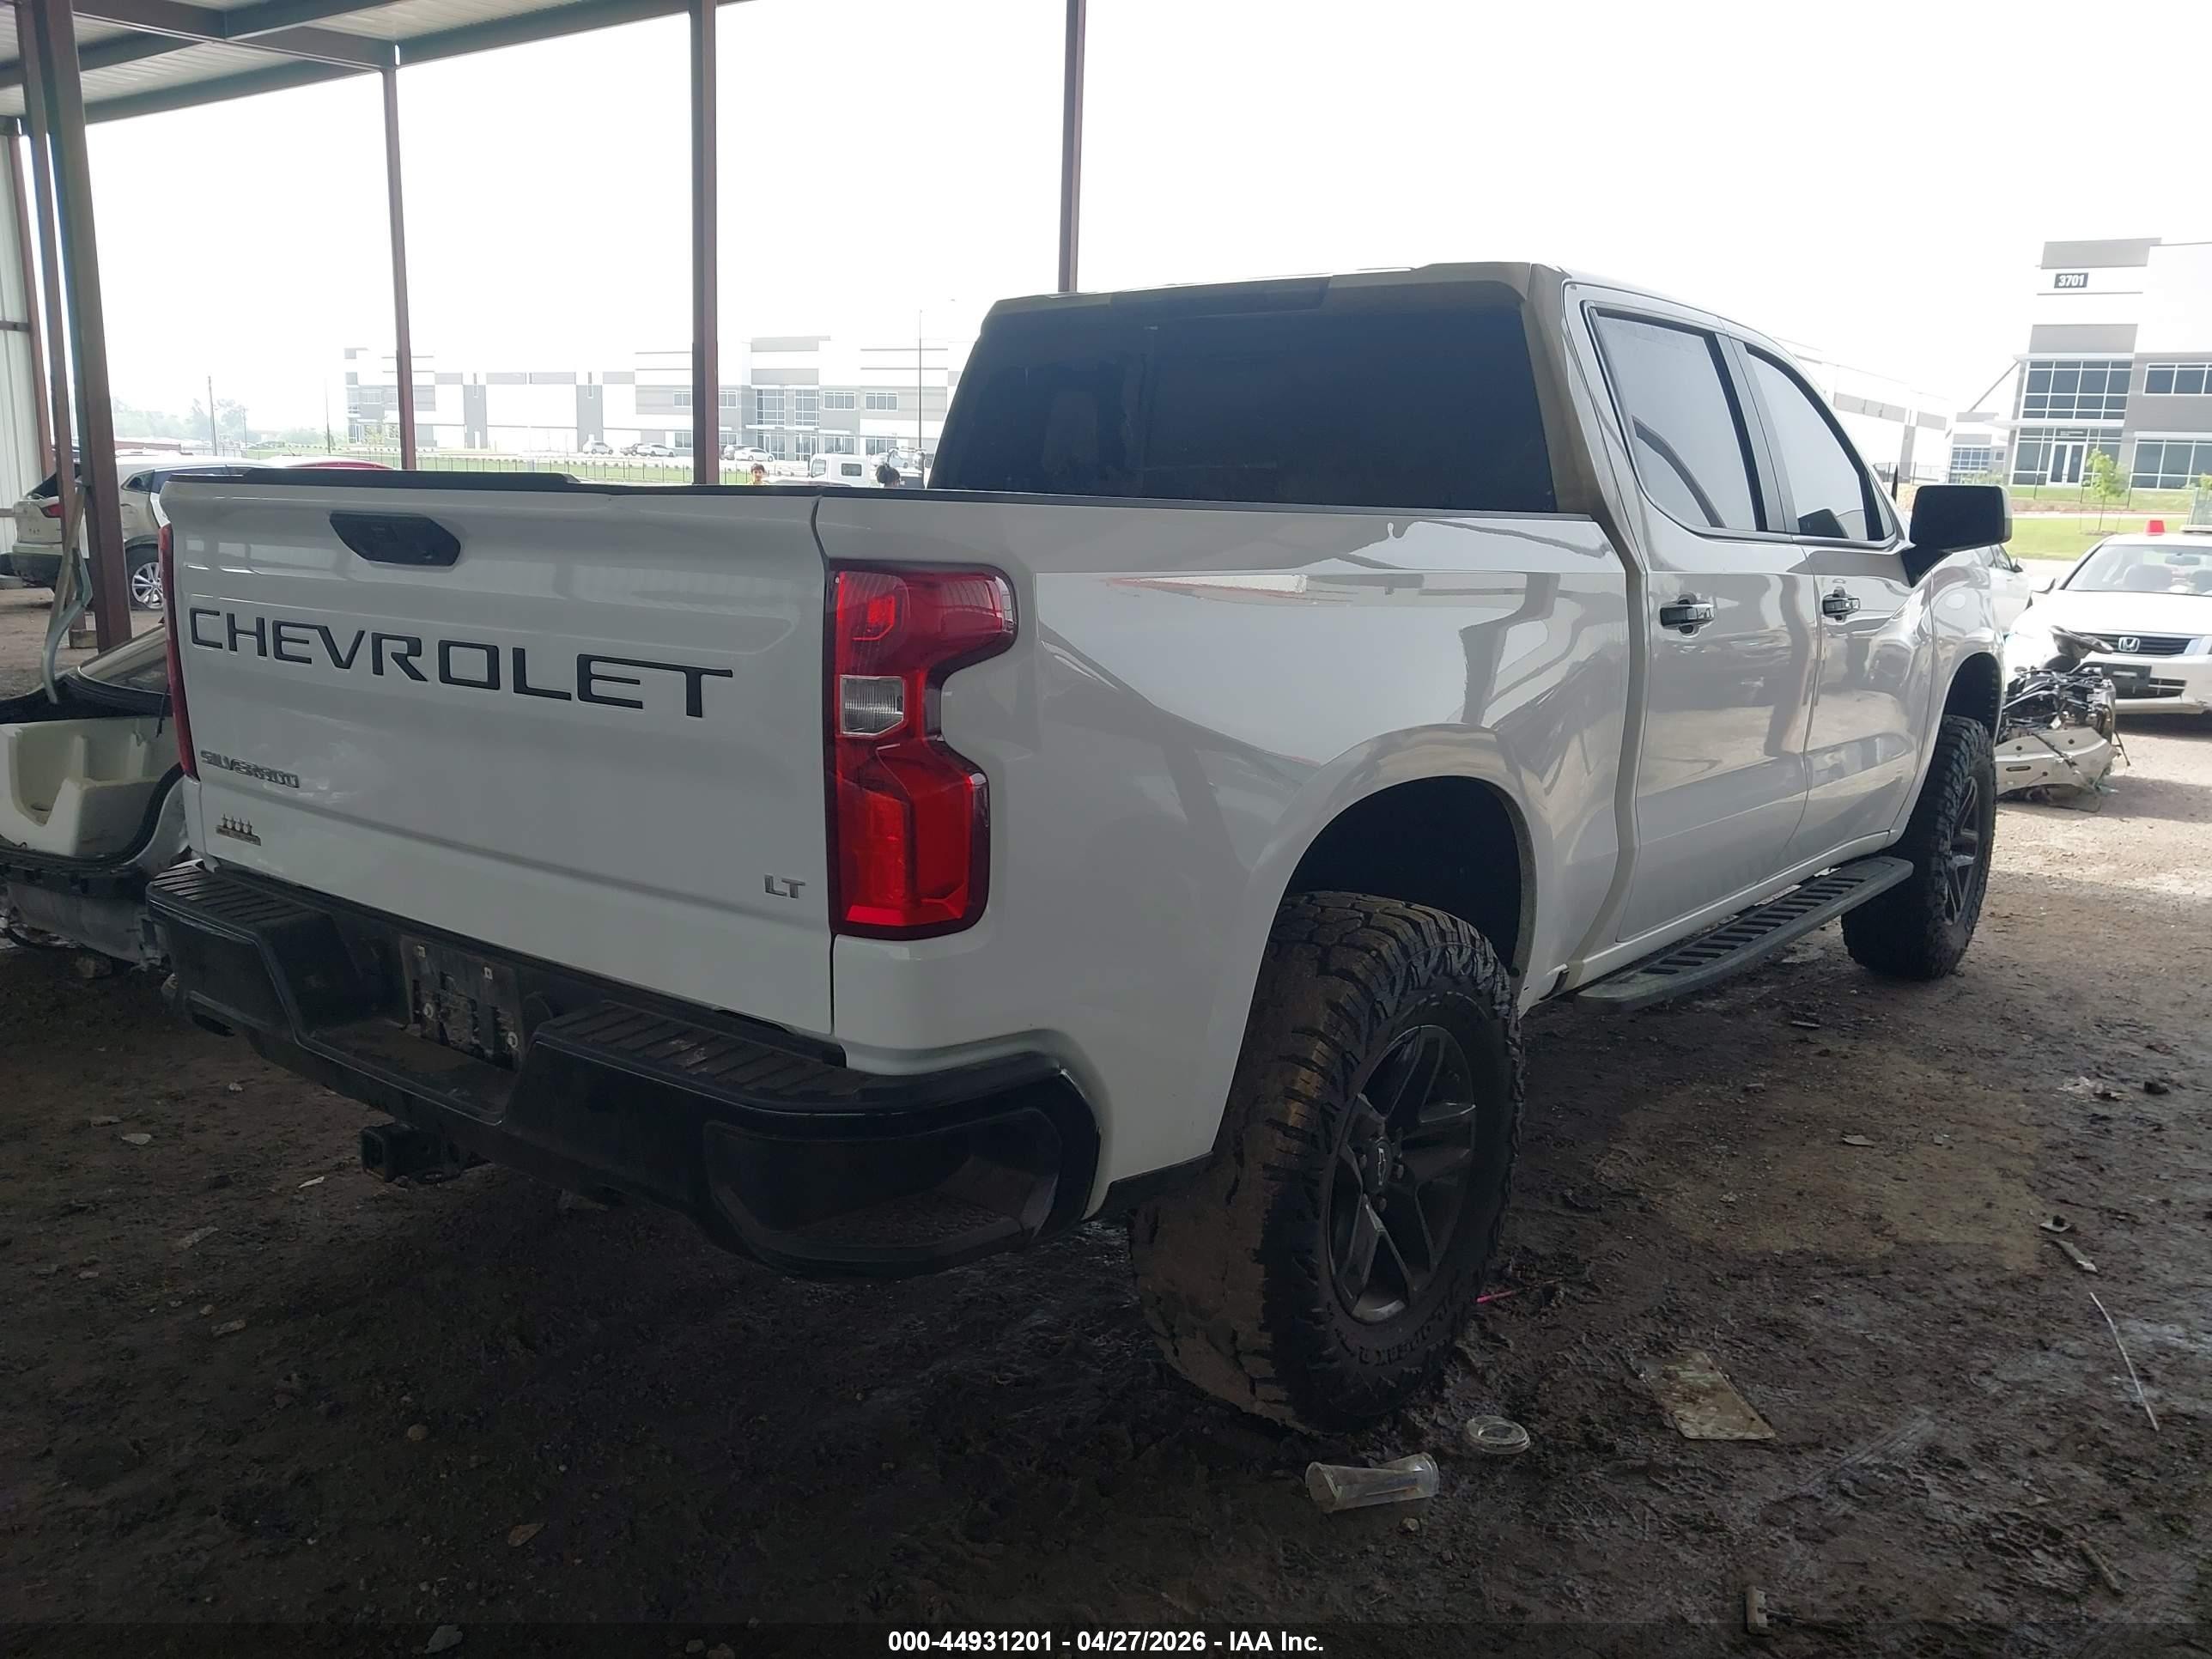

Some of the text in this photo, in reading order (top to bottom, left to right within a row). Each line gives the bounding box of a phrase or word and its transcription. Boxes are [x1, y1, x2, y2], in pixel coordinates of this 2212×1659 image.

[2058, 274, 2085, 287] 3701
[188, 606, 733, 719] CHEVROLET
[764, 875, 805, 899] LT
